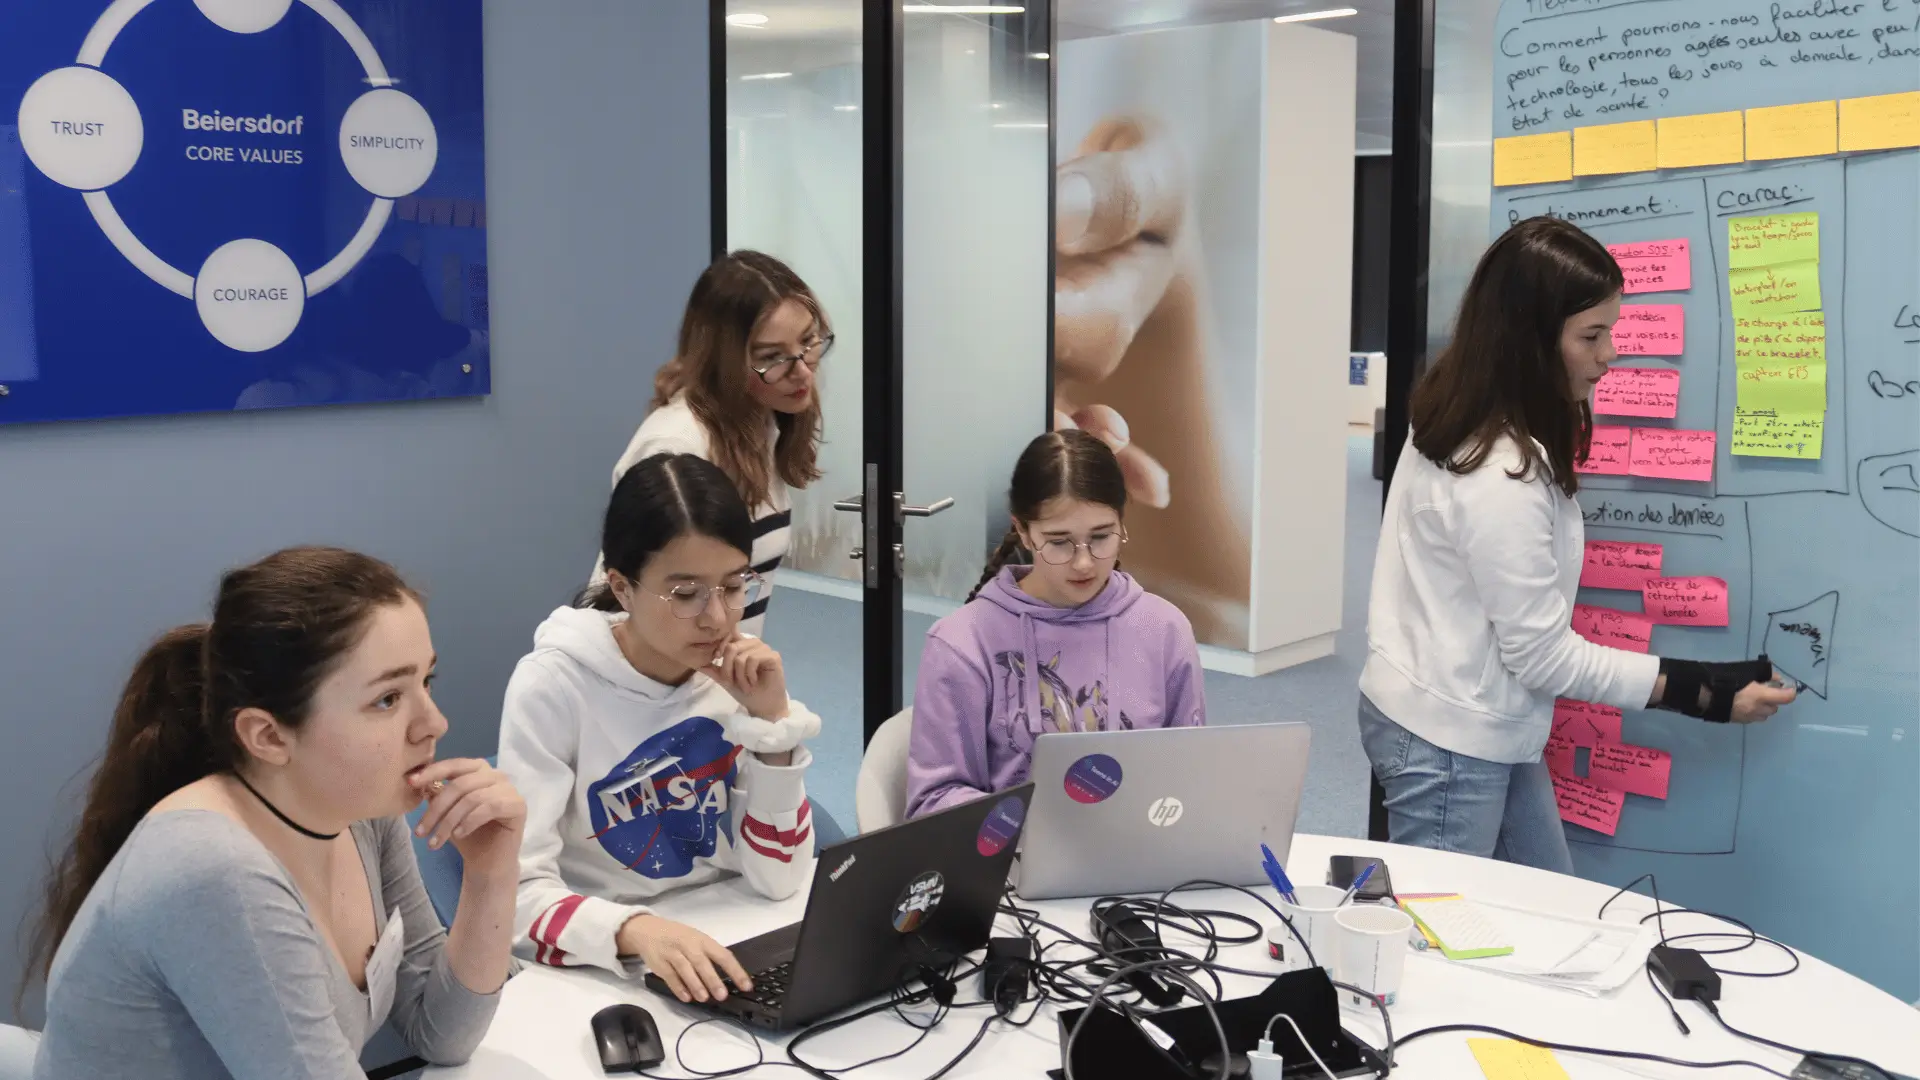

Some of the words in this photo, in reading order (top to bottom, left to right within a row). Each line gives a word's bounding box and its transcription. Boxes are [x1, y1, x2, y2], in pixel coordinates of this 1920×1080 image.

[1500, 26, 1608, 58] Comment
[1770, 0, 1865, 29] faciliter
[1506, 65, 1550, 91] pour
[1559, 55, 1581, 74] les
[1588, 47, 1672, 72] personnes
[1735, 27, 1801, 50] seules
[1809, 28, 1861, 41] avec
[1872, 22, 1909, 45] peu
[1618, 71, 1659, 88] tous
[1668, 63, 1693, 81] les
[1700, 58, 1743, 79] jours
[1758, 54, 1779, 68] à
[1563, 103, 1585, 120] de
[1595, 92, 1650, 115] santé
[51, 120, 104, 138] TRUST
[182, 108, 304, 135] Beiersdorf
[185, 145, 235, 162] CORE
[238, 147, 304, 165] VALUES
[350, 135, 425, 152] SIMPLICITY
[212, 287, 289, 302] COURAGE
[1637, 503, 1663, 523] des
[1667, 502, 1725, 528] données
[1600, 612, 1624, 625] pas
[597, 773, 728, 829] NASA
[1150, 797, 1179, 826] hp
[829, 853, 857, 882] ThinkPad
